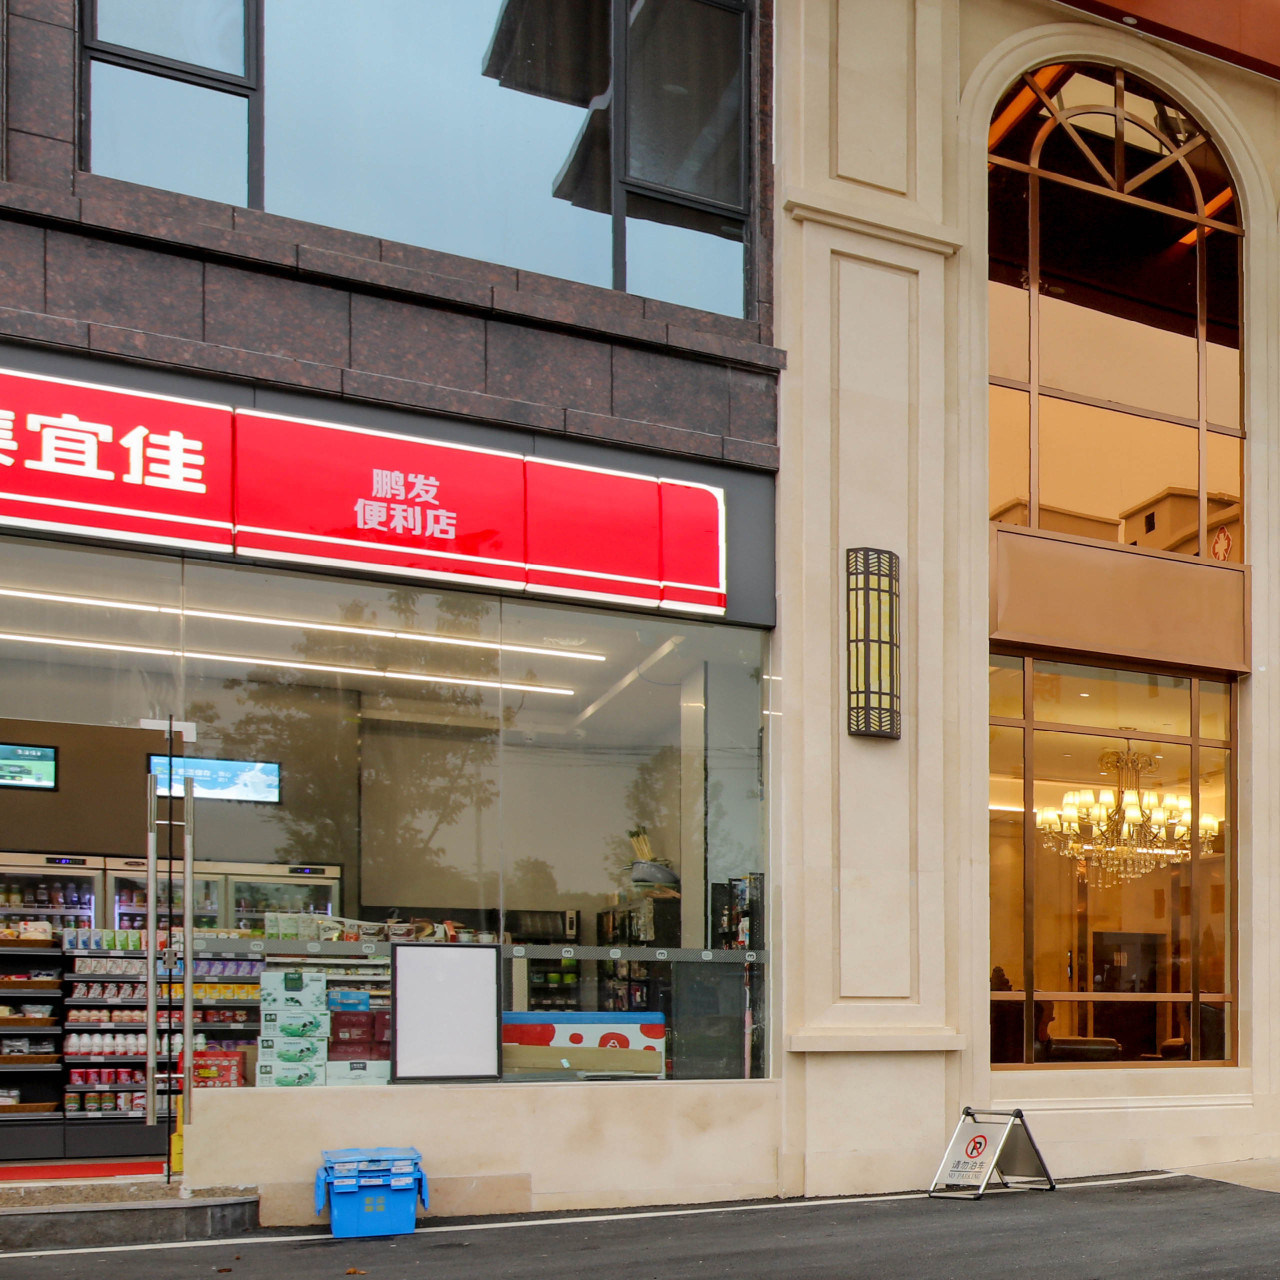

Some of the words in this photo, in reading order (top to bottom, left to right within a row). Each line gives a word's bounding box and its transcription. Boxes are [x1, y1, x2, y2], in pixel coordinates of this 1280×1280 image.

[0, 410, 207, 495] 宜佳
[371, 468, 440, 506] 鹏发
[353, 498, 457, 539] 便利店
